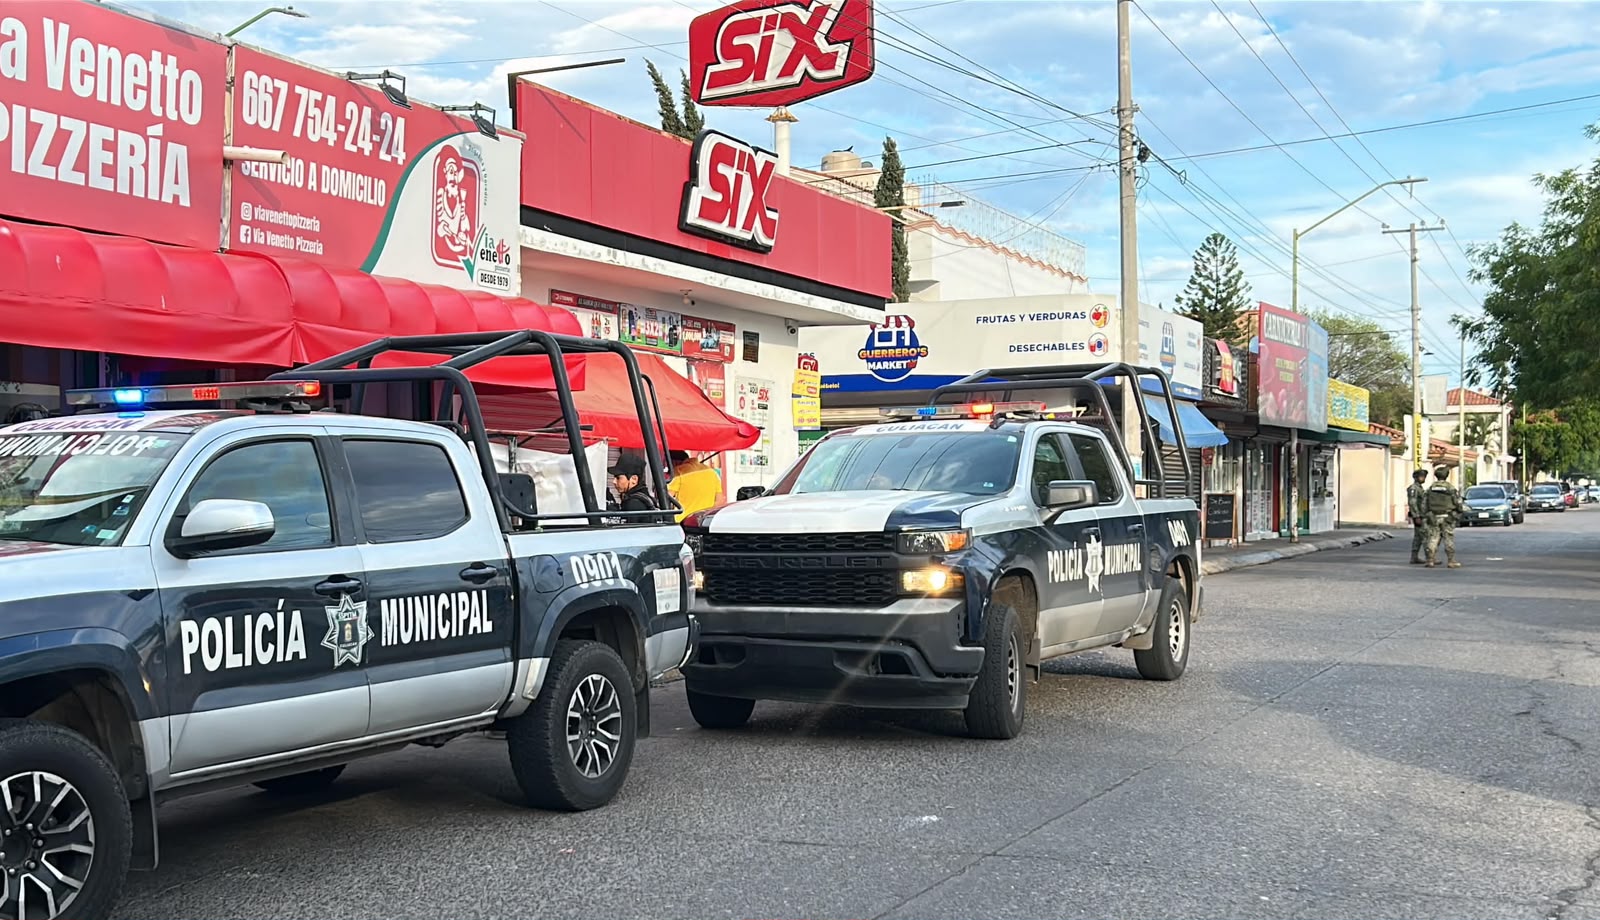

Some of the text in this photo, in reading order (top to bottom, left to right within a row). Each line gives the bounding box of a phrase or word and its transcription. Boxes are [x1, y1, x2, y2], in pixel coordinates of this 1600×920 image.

[43, 17, 203, 125] Venetto
[242, 70, 406, 165] 667 754-24-24
[308, 162, 317, 192] A
[321, 165, 386, 208] DOMICILIO
[254, 205, 320, 233] viavenettopizzeria
[253, 227, 323, 255] Via Venetto Pizzeria
[480, 273, 509, 287] DESDE 1979
[976, 311, 1087, 324] FRUTAS Y VERDURAS
[858, 346, 928, 359] GUERRERO'S
[1009, 342, 1085, 353] DESECHABLES
[867, 360, 909, 371] MARKET
[876, 423, 964, 432] CULIACAN
[570, 551, 627, 589] 0901
[1047, 541, 1142, 583] POLICÍA MUNICIPAL
[180, 589, 493, 675] POLICÍA MUNICIPAL
